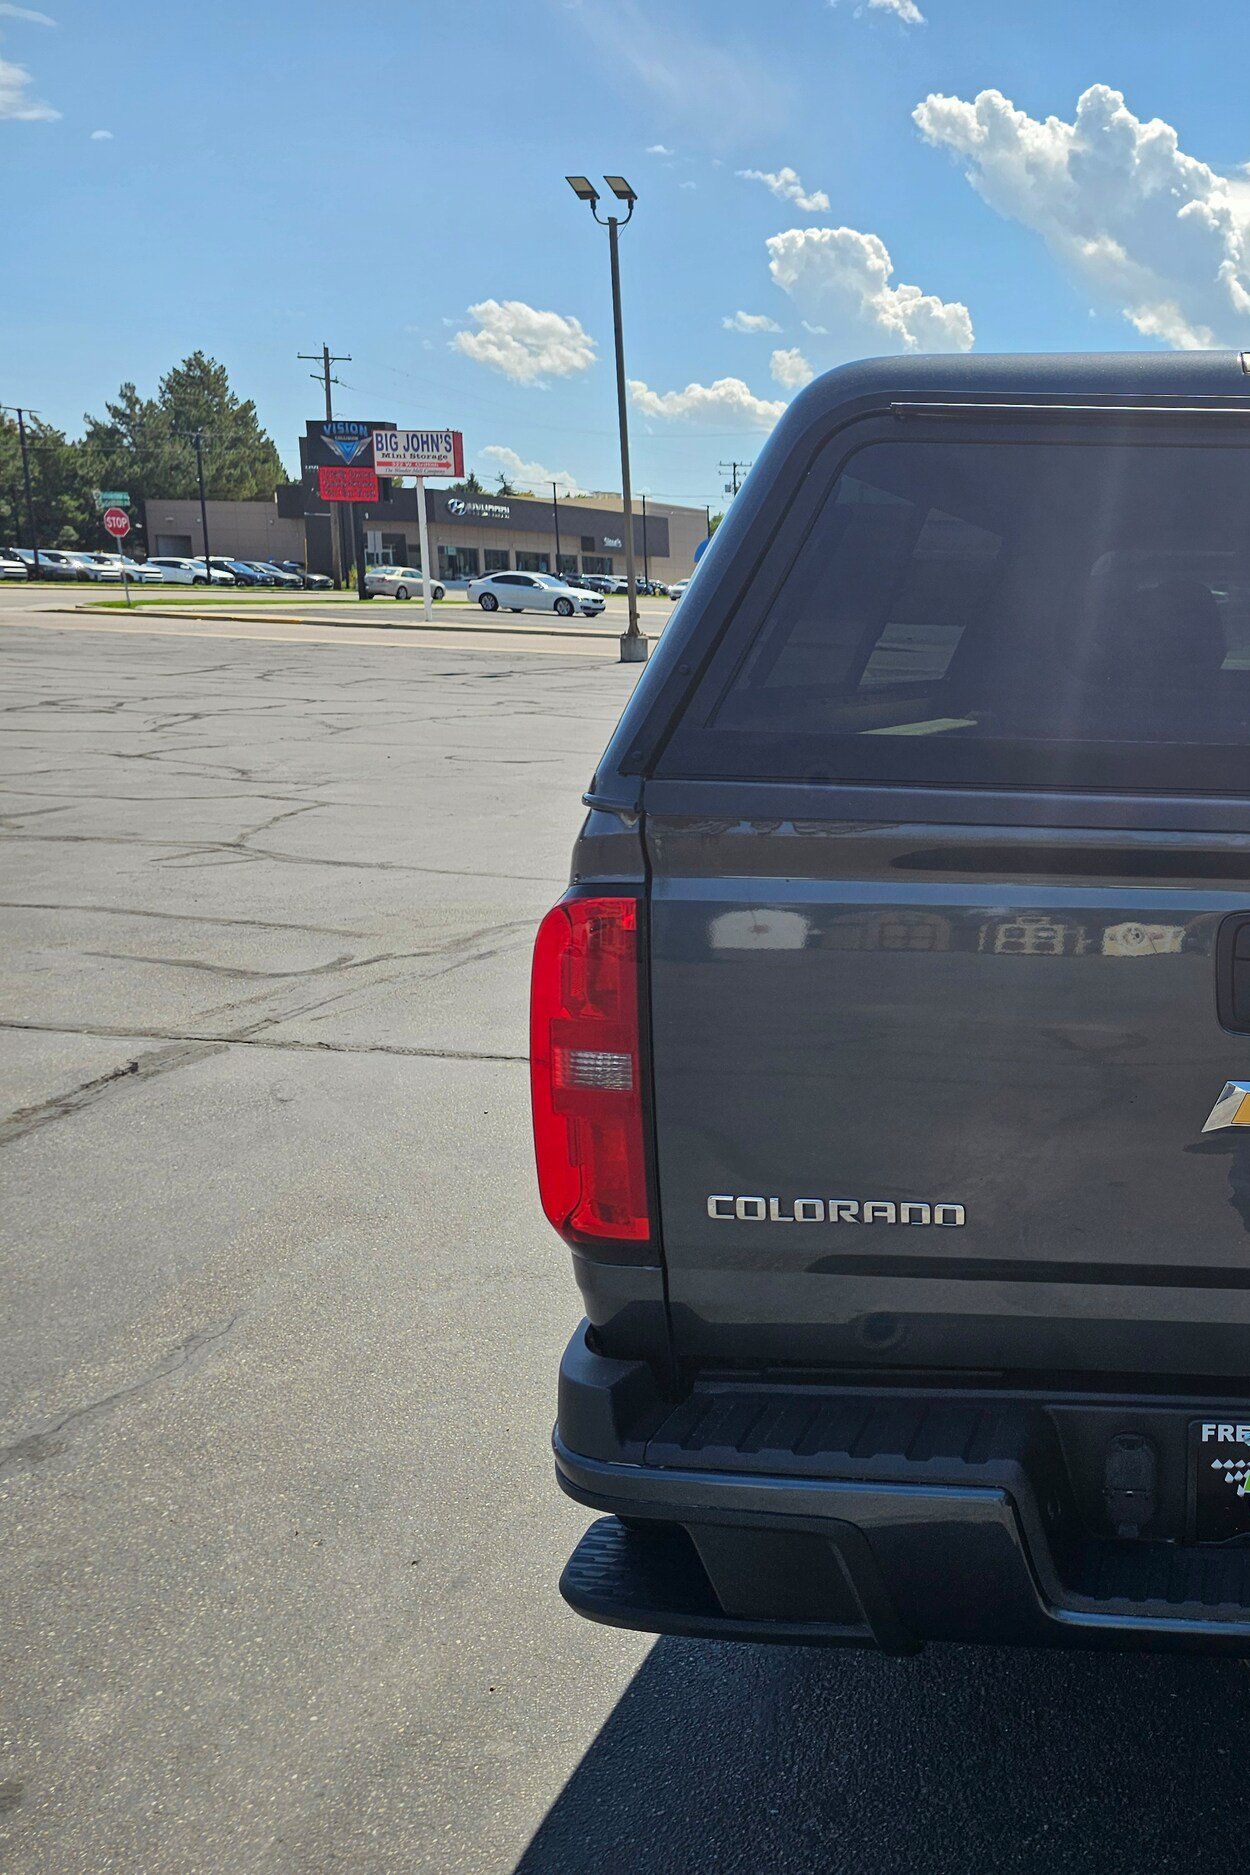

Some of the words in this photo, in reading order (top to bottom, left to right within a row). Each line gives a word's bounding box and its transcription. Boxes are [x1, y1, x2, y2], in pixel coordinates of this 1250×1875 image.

[323, 422, 369, 437] VISION
[375, 432, 398, 451] BIG
[403, 433, 452, 453] JOHN'S
[410, 453, 448, 461] Storage
[106, 516, 127, 528] STOP
[707, 1195, 966, 1226] COLORADO
